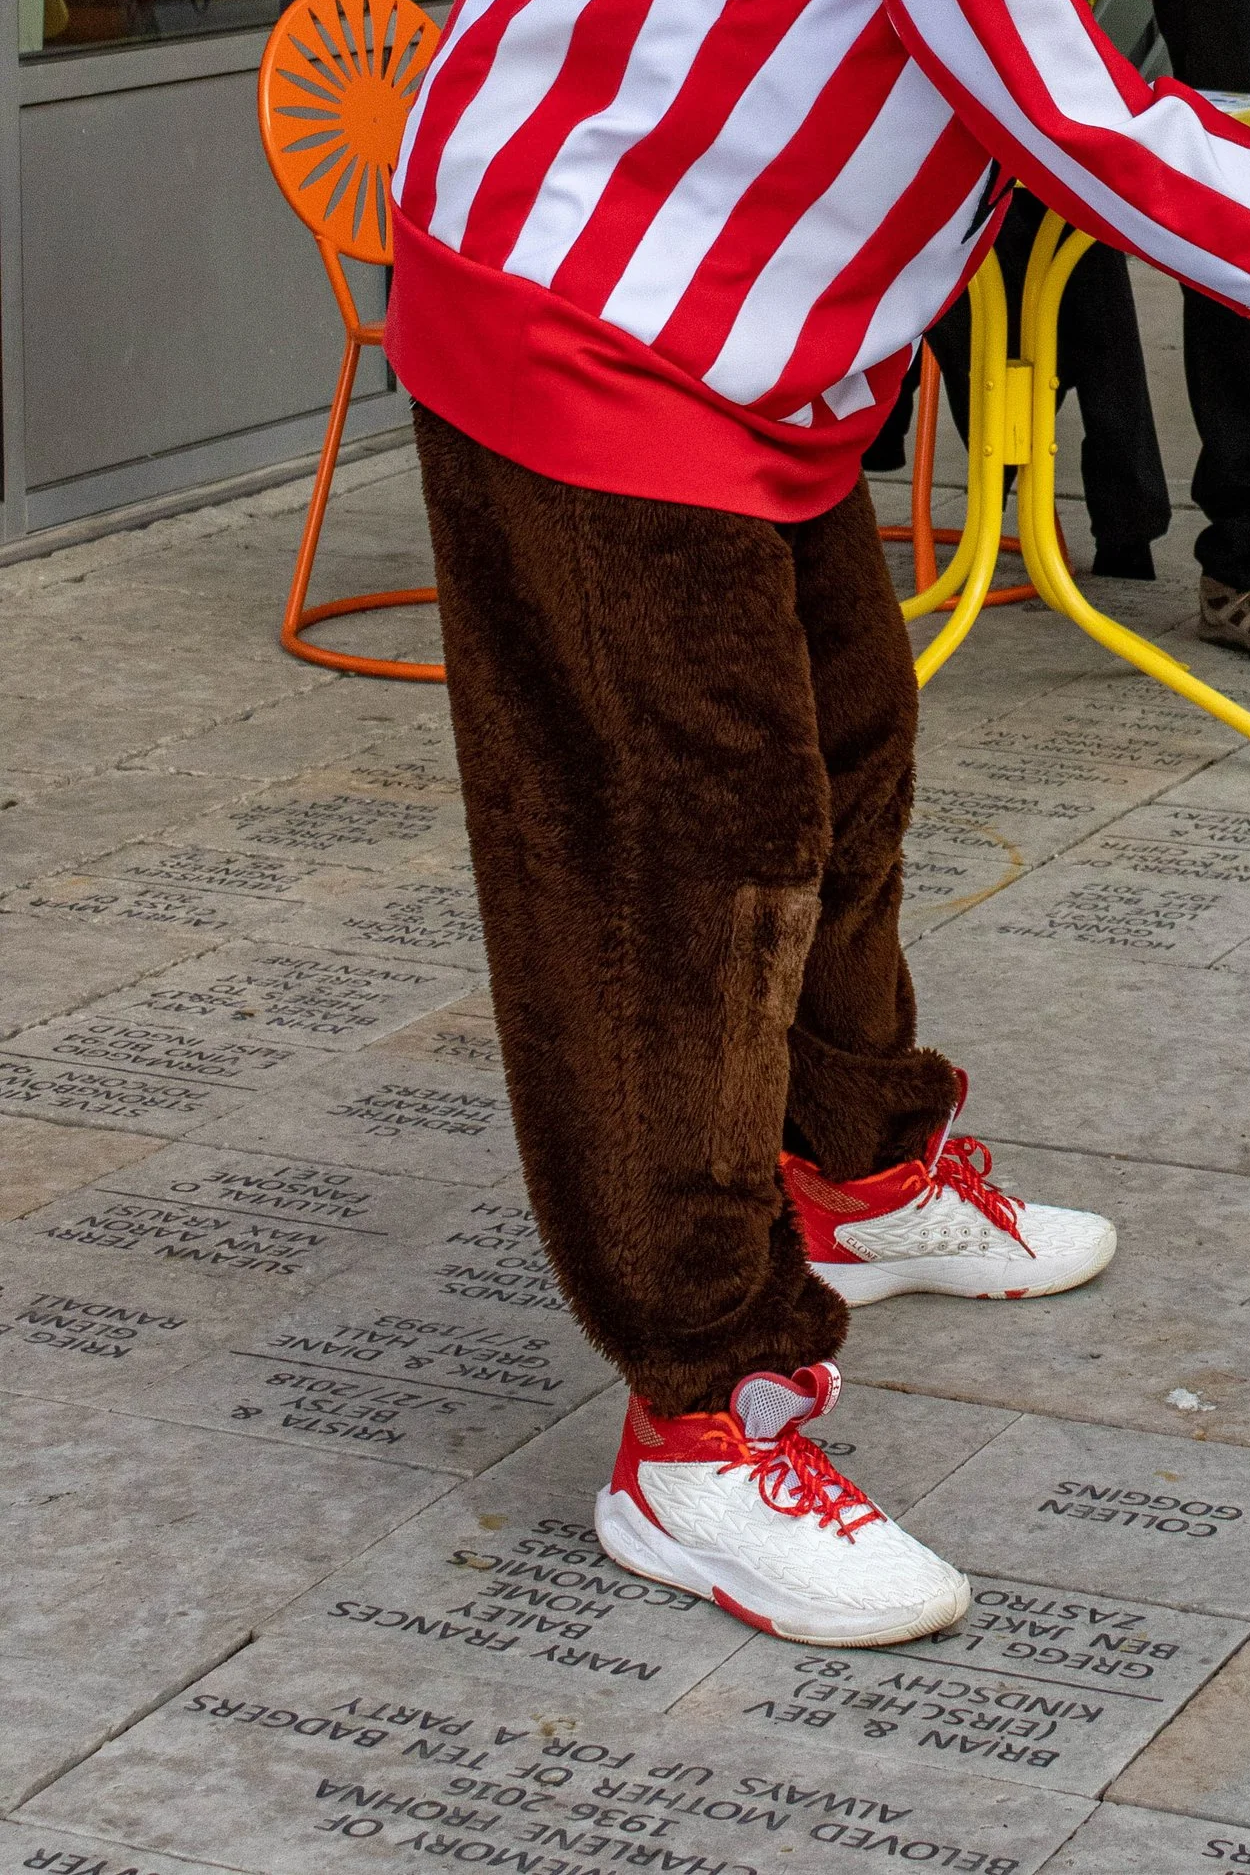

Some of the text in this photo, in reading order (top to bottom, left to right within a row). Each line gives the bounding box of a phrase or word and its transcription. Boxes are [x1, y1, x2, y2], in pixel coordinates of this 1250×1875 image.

[52, 1045, 241, 1077] FORMAGGIO
[164, 1048, 240, 1065] VINO
[215, 1043, 294, 1060] ELISE
[56, 1072, 209, 1099] POPCORN
[47, 1096, 148, 1118] STEVE
[326, 1104, 485, 1137] PEDIATRIC
[352, 1094, 495, 1122] THERAPY
[201, 1171, 370, 1204] FANSOME
[219, 1186, 368, 1220] ALLUVIAL
[74, 1215, 309, 1258] JENN AARON
[104, 1203, 326, 1246] MAX KRAUS!
[34, 1226, 301, 1276] SUEANN TERRY
[14, 1310, 137, 1339] GLENN
[29, 1292, 187, 1331] RANDALL
[373, 1312, 549, 1350] 8/7/1993
[23, 1330, 131, 1359] KRIEG
[266, 1333, 562, 1392] MARK DIANE
[330, 1324, 549, 1369] GREAT HALL
[265, 1371, 466, 1415] 5/27/2018
[278, 1394, 398, 1423] BETSY
[281, 1412, 403, 1445] KRISTA
[1037, 1498, 1217, 1538] COLLEEN
[1053, 1480, 1243, 1520] GOGGINS
[445, 1549, 699, 1612] ECONOMICS
[477, 1580, 614, 1619] HOME
[445, 1600, 593, 1640] BAILEY
[970, 1612, 1179, 1660] BEN JAKE
[327, 1601, 662, 1682] MARY FRANCES
[1001, 1642, 1154, 1681] GREGG
[793, 1655, 1104, 1723] KINDSCHY '82
[792, 1679, 1057, 1742] (EIRSCHELE)
[740, 1699, 1060, 1768] BRIAN BEV
[328, 1696, 913, 1824] ALWAYS UP FOR PARTY
[183, 1694, 1021, 1875] BELOVED MOTHER OF TEN BADGERS
[314, 1778, 502, 1832] FROHNA
[314, 1815, 382, 1838] OF
